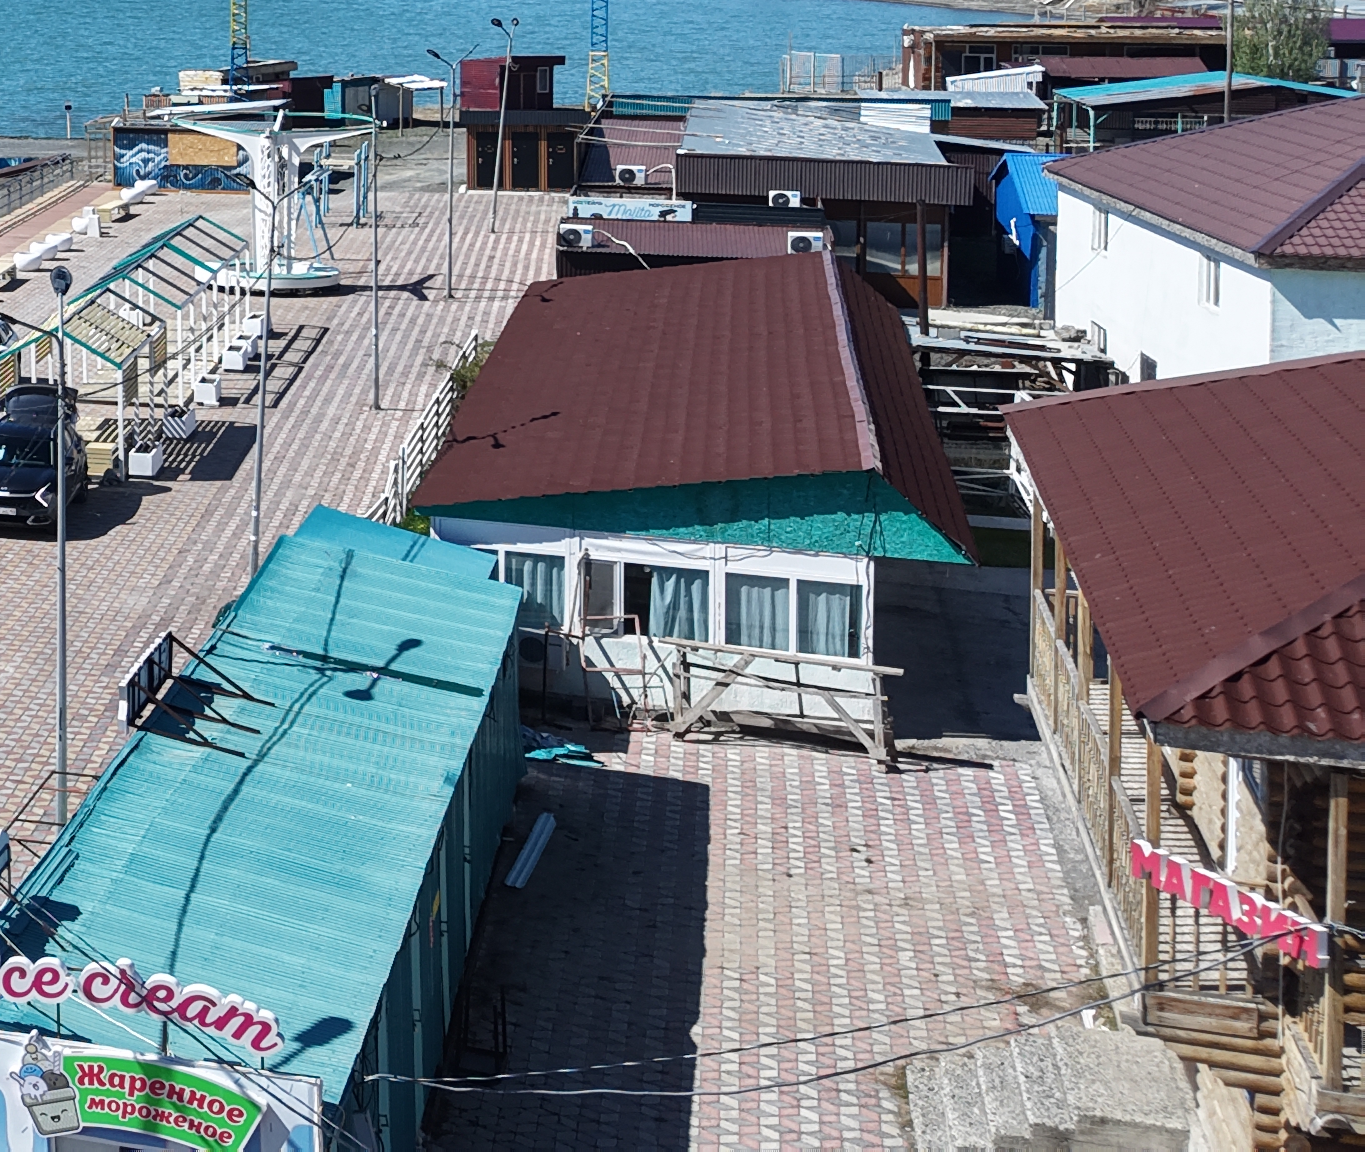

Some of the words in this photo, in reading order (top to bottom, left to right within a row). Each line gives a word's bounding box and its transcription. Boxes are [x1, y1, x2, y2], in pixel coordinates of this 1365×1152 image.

[604, 202, 654, 219] Mojito
[1130, 839, 1325, 969] МАГАЗИН
[82, 968, 279, 1052] cream
[75, 1062, 247, 1124] Жаренное
[86, 1095, 234, 1145] мороженое
